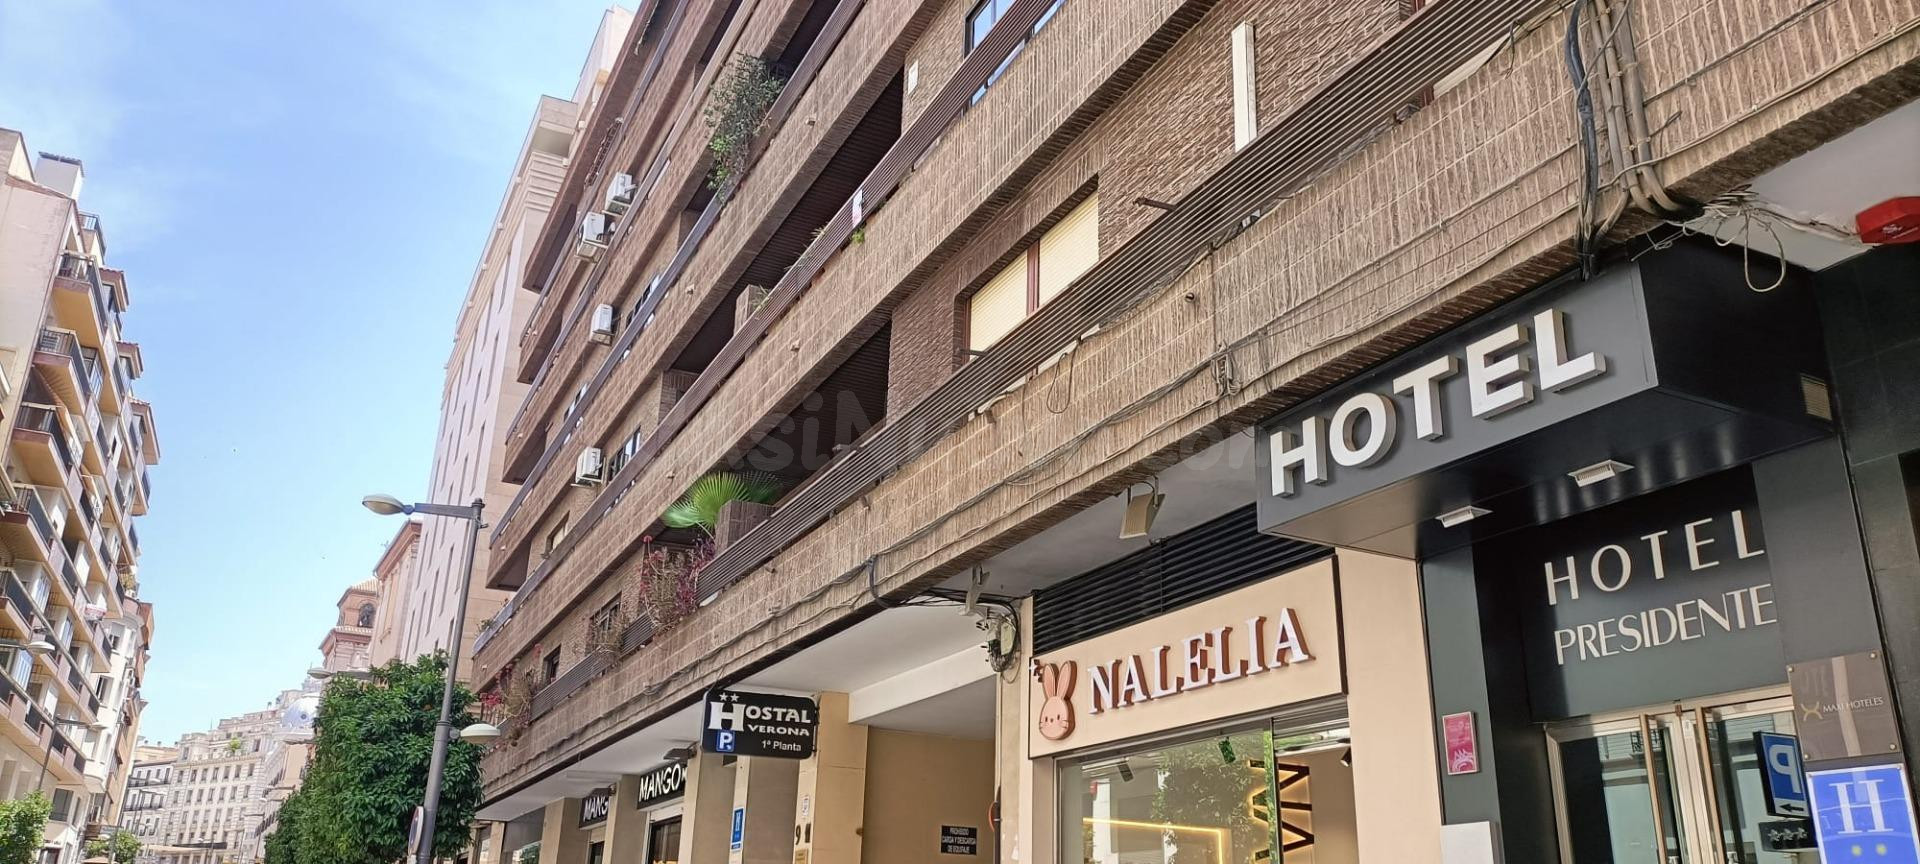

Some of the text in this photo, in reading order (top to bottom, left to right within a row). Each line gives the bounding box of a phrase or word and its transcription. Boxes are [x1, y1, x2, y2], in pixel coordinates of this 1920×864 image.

[1270, 308, 1606, 498] HOTEL
[1544, 510, 1765, 606] HOTEL
[1554, 583, 1777, 665] PRESIDENTE
[1087, 607, 1317, 715] NALELIA
[708, 701, 811, 731] HOSTAL
[1846, 696, 1884, 710] HOTELES
[719, 732, 734, 749] P
[747, 724, 810, 736] VERONA
[772, 740, 801, 752] Planta
[639, 763, 681, 802] MANGO
[1829, 779, 1894, 835] H
